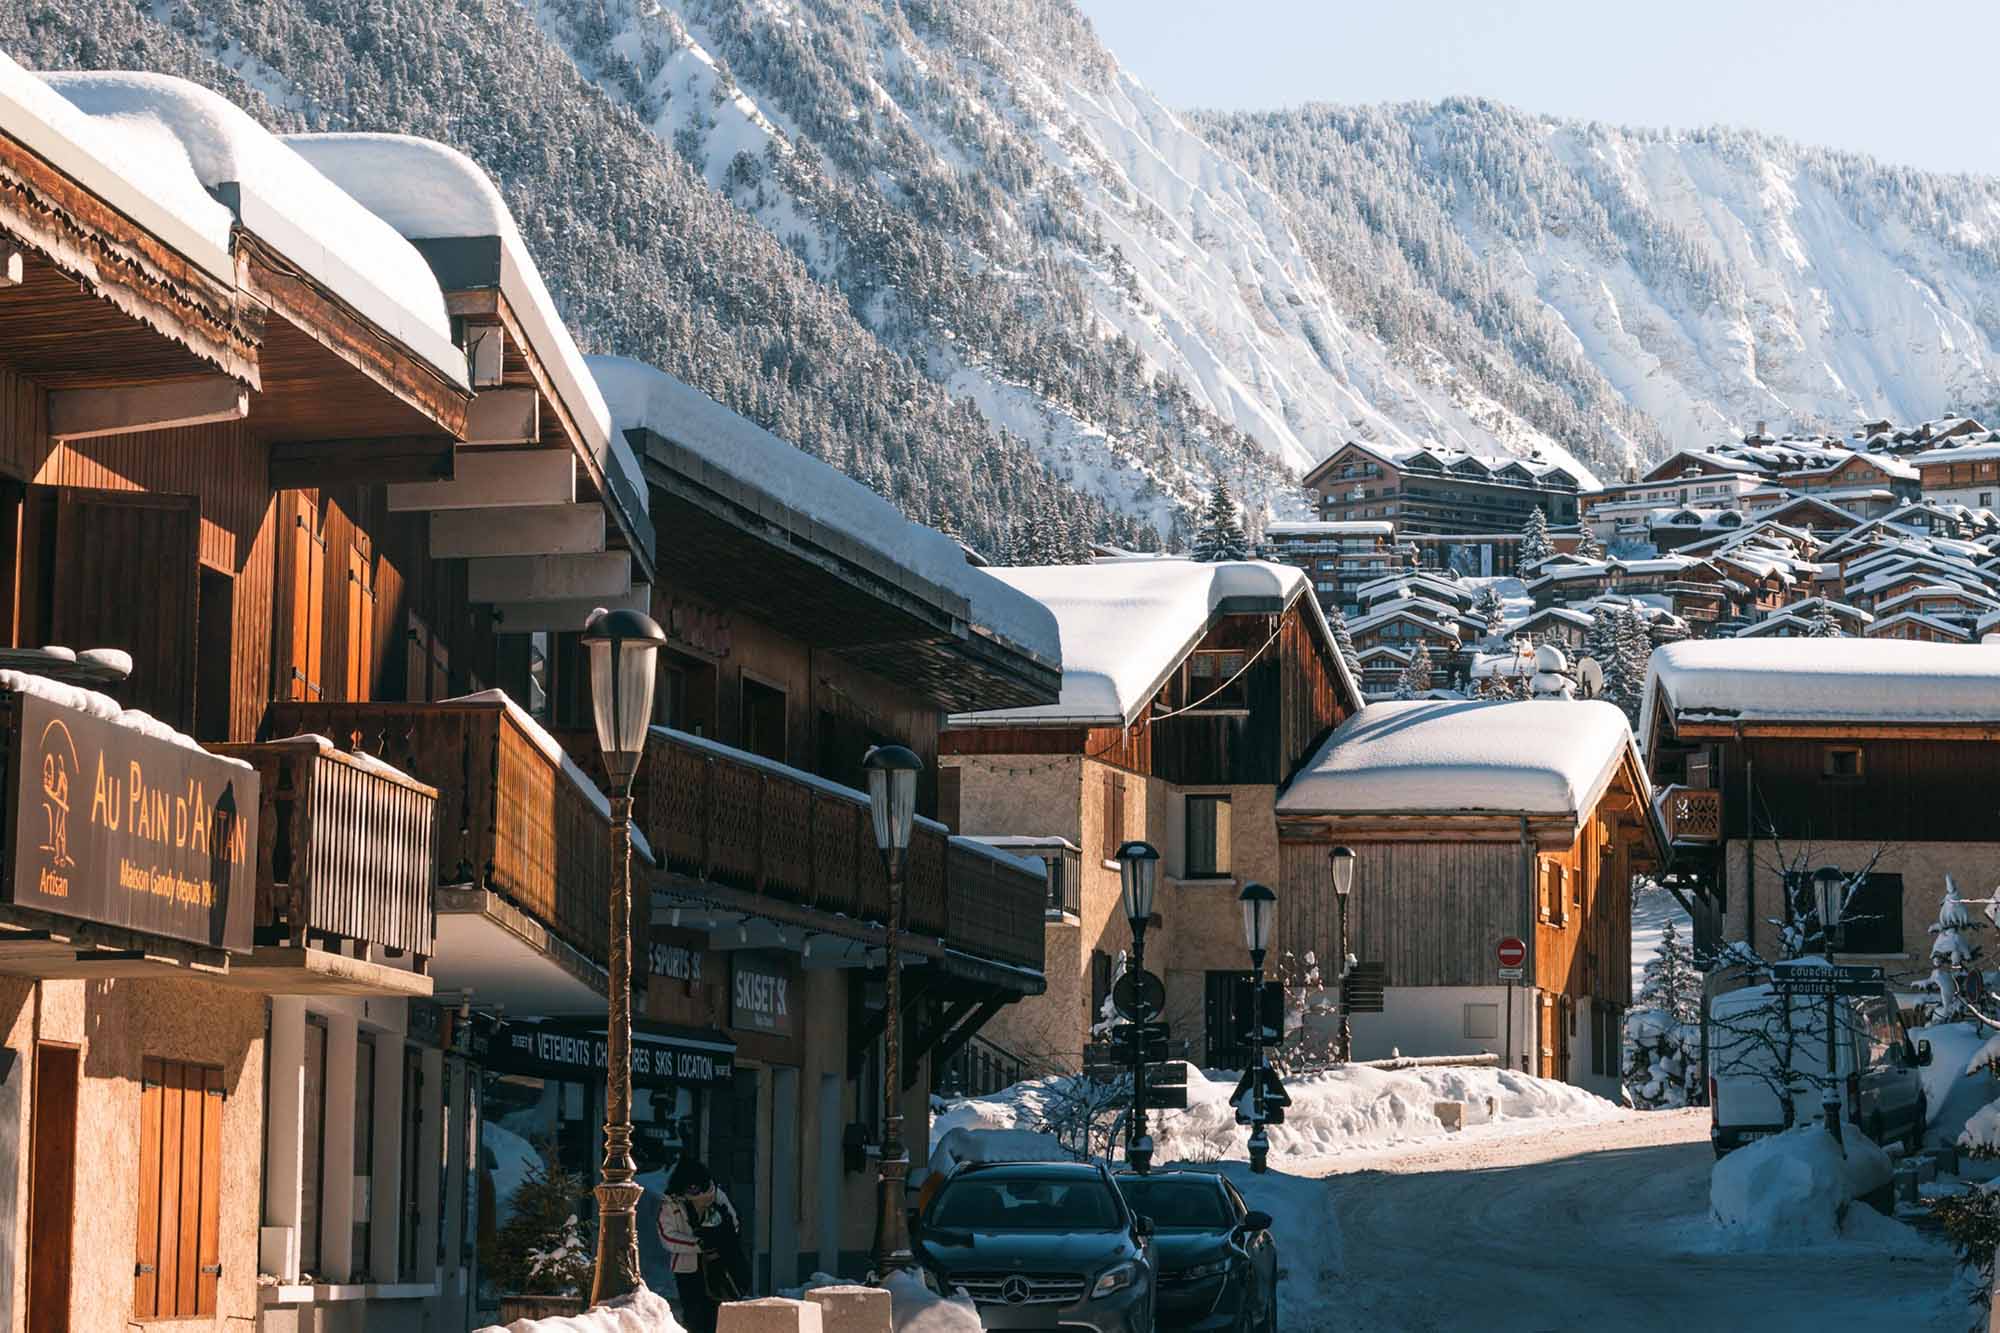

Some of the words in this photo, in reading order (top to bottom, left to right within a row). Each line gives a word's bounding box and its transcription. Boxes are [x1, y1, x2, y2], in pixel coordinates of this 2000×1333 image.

[128, 760, 169, 846] PAIN
[39, 867, 69, 897] Artisan
[120, 858, 149, 892] Maison
[176, 871, 200, 911] depuis
[655, 943, 690, 980] SPORTS
[1790, 967, 1849, 978] COURCHEVEL
[736, 969, 776, 1014] SKISET
[1790, 983, 1837, 993] MOUTIERS
[537, 1032, 590, 1067] VETEMENTS
[655, 1050, 673, 1076] SKIS
[677, 1053, 713, 1080] LOCATION
